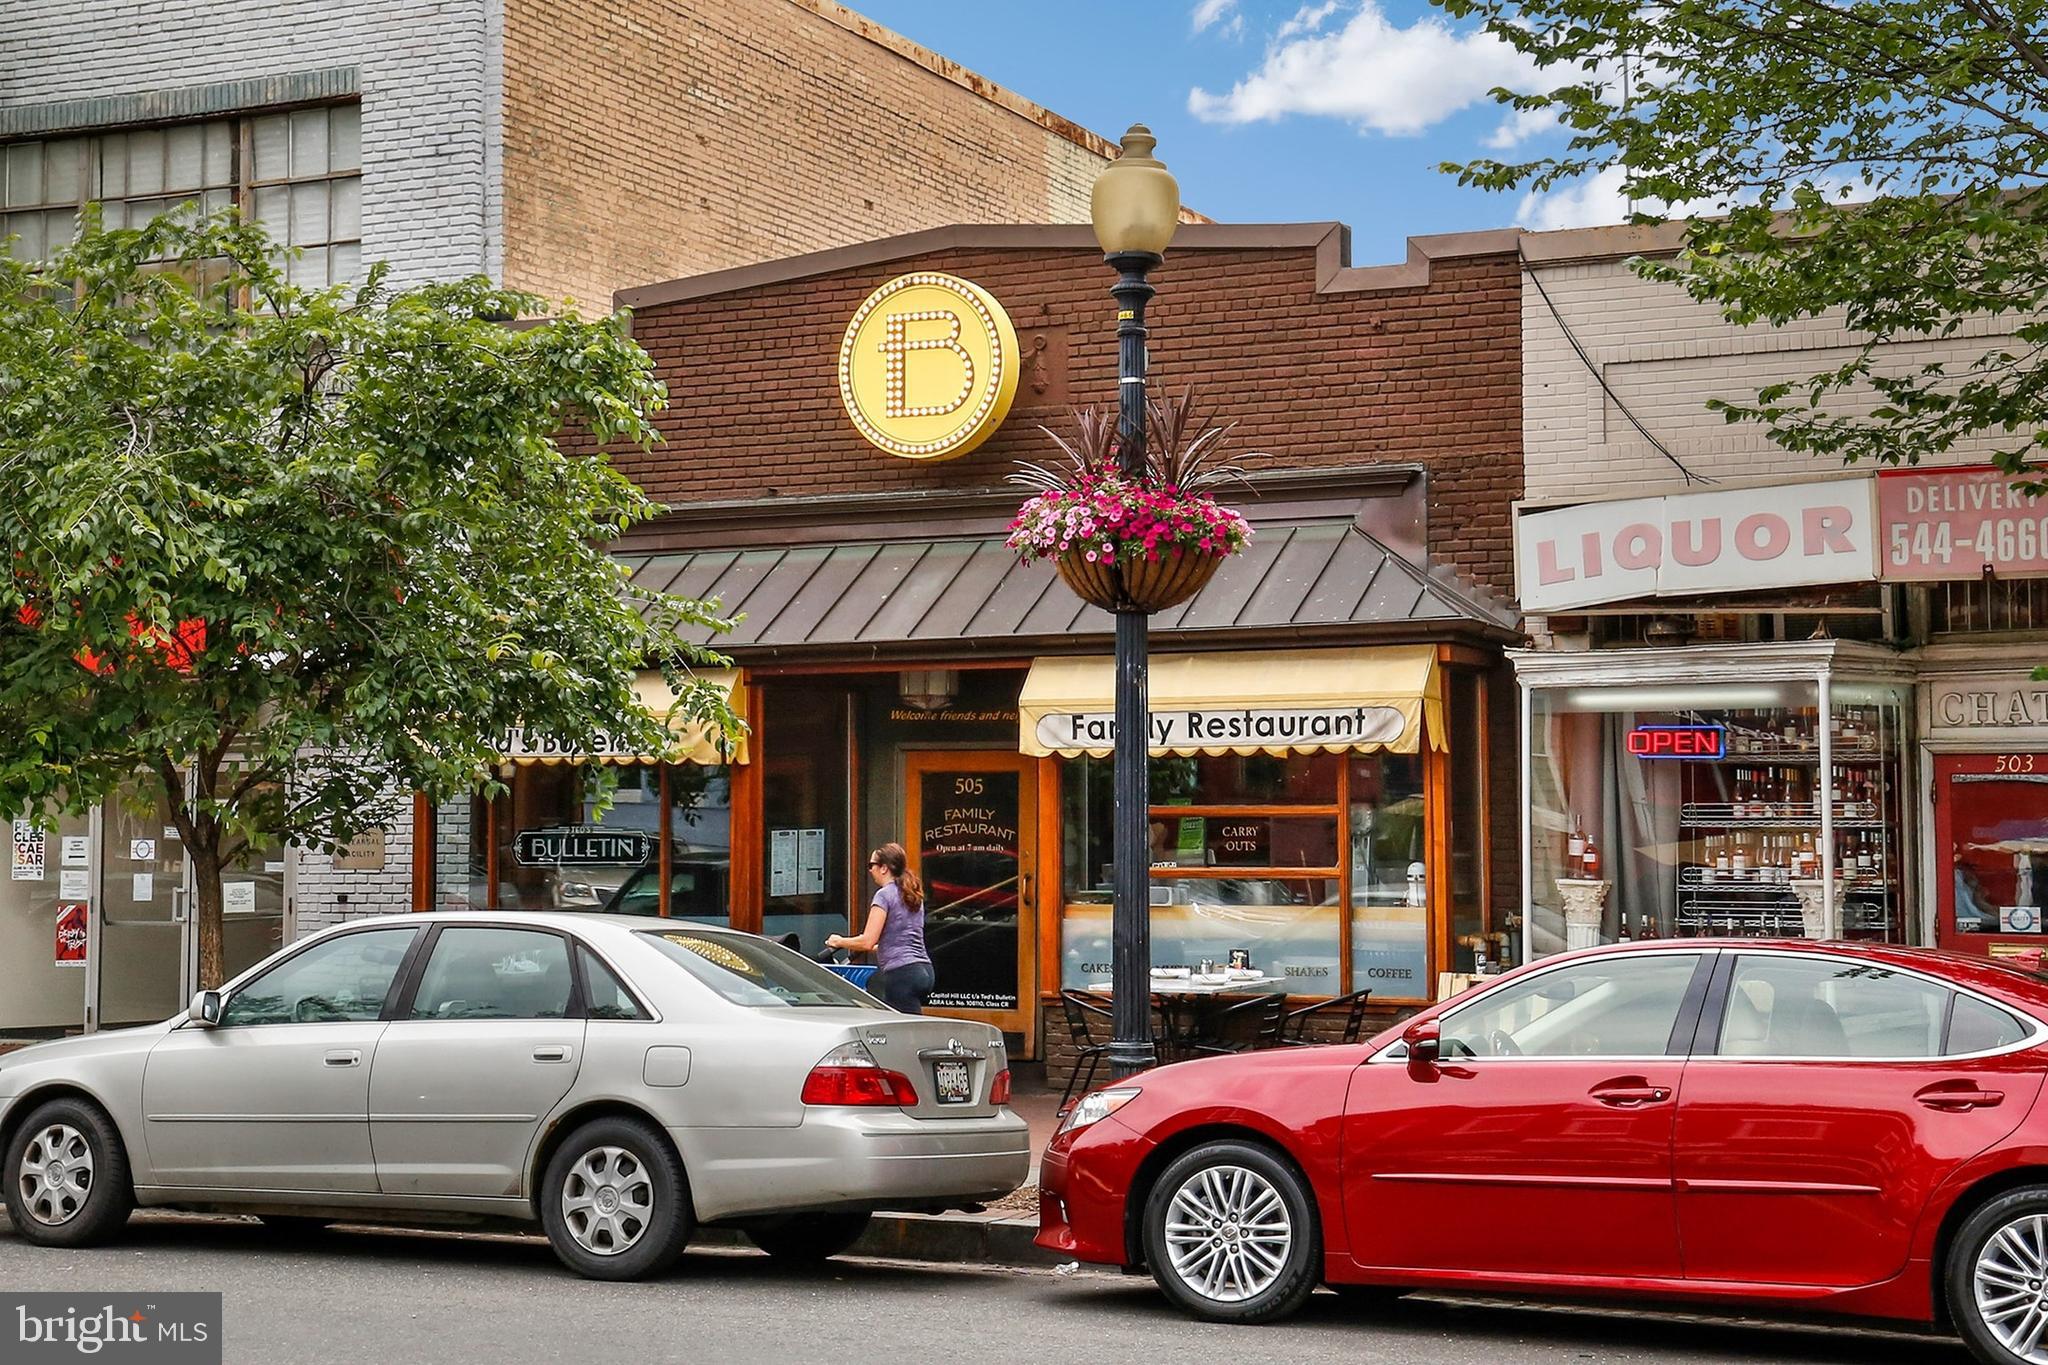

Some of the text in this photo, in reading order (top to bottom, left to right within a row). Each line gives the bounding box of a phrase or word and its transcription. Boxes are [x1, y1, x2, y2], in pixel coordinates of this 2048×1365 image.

[878, 310, 975, 418] B
[1536, 506, 1857, 586] LIQUOR
[890, 710, 938, 720] Welcome
[940, 710, 977, 720] friends
[979, 710, 999, 720] and
[1071, 707, 1366, 745] Faly Restaurant
[1627, 731, 1717, 753] OPEN
[1994, 754, 2034, 773] 503
[955, 778, 984, 795] 505
[944, 807, 996, 821] FAMILY
[924, 823, 1016, 842] RESTAURANT
[1222, 826, 1258, 837] CARRY
[531, 838, 634, 857] BULLETIN
[936, 844, 956, 853] Open
[986, 844, 1004, 853] daily
[1226, 841, 1257, 851] OUTS
[18, 854, 43, 865] SAR
[1285, 967, 1328, 977] SHAKES
[1368, 968, 1412, 979] COFFEE
